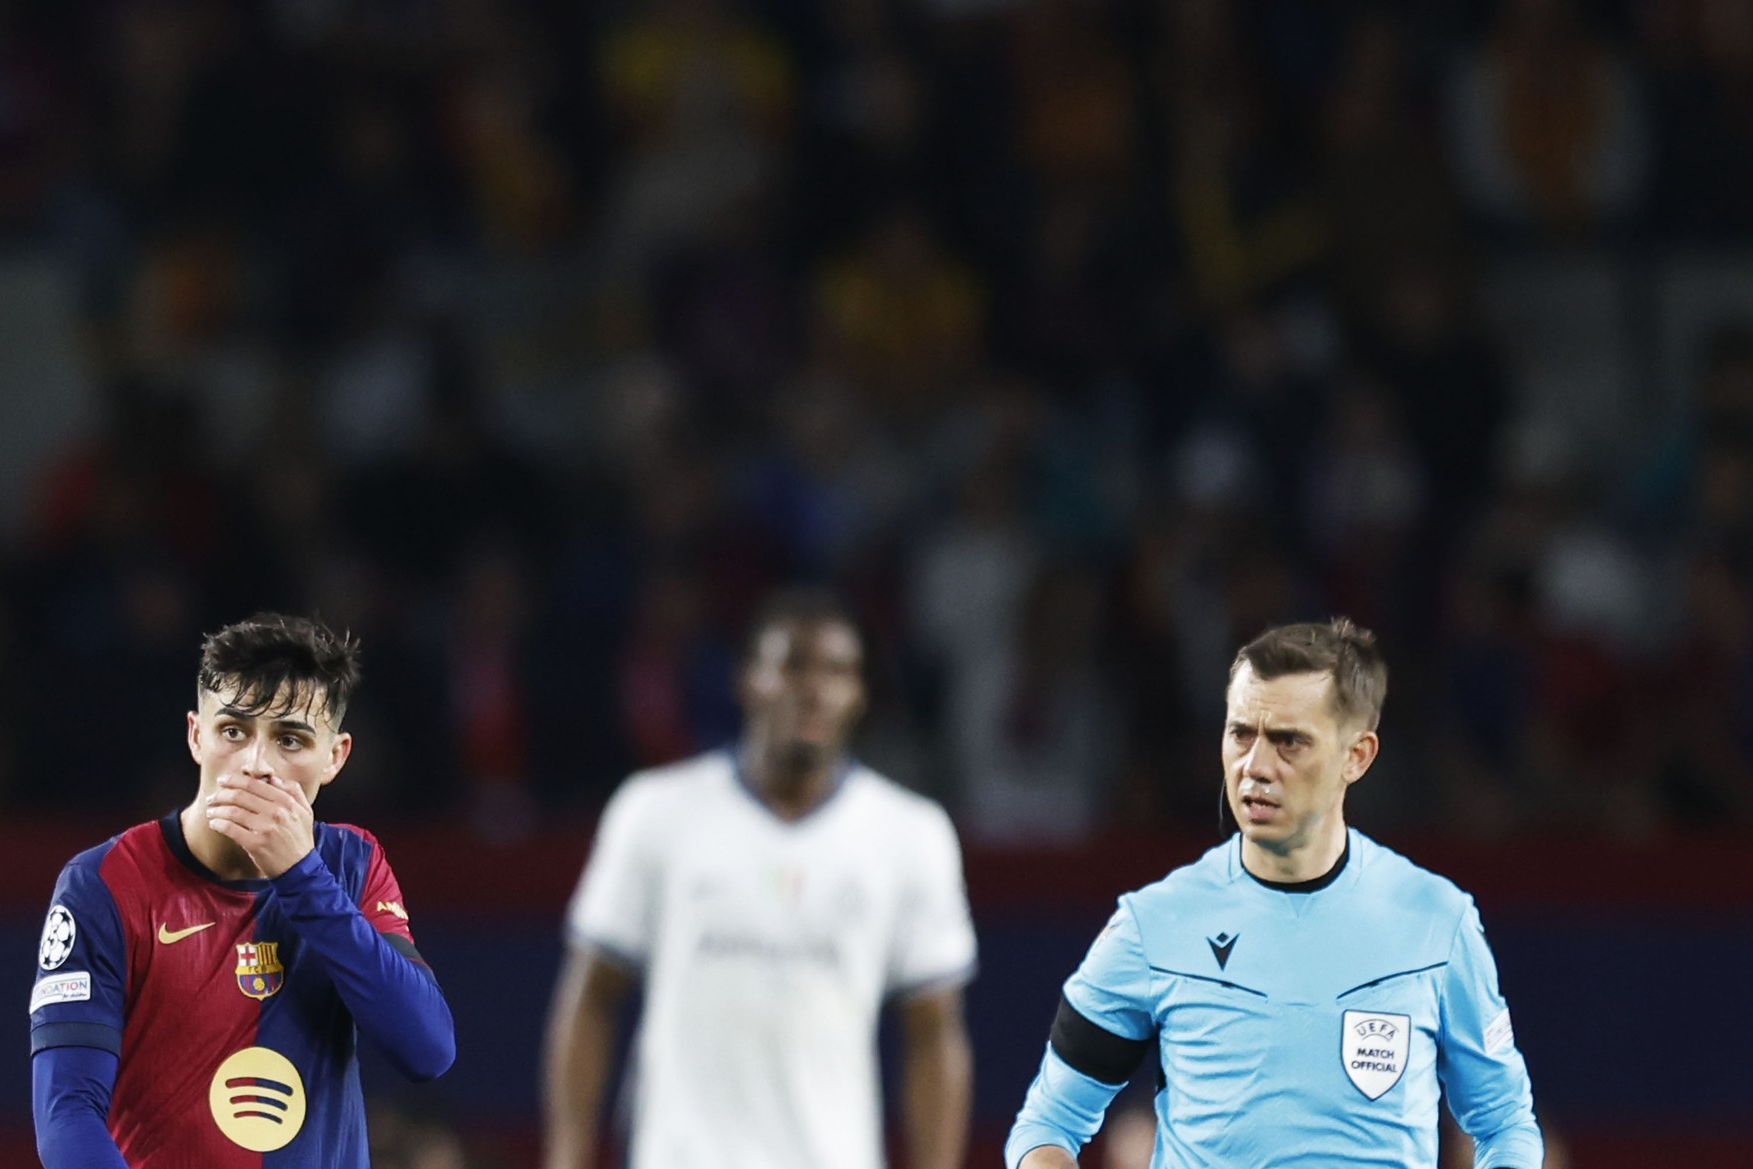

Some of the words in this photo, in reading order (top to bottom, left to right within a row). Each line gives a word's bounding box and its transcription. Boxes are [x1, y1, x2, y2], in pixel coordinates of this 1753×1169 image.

[1357, 1022, 1396, 1039] UEFA
[1357, 1047, 1395, 1059] MATCH
[1351, 1060, 1397, 1073] OFFICIAL
